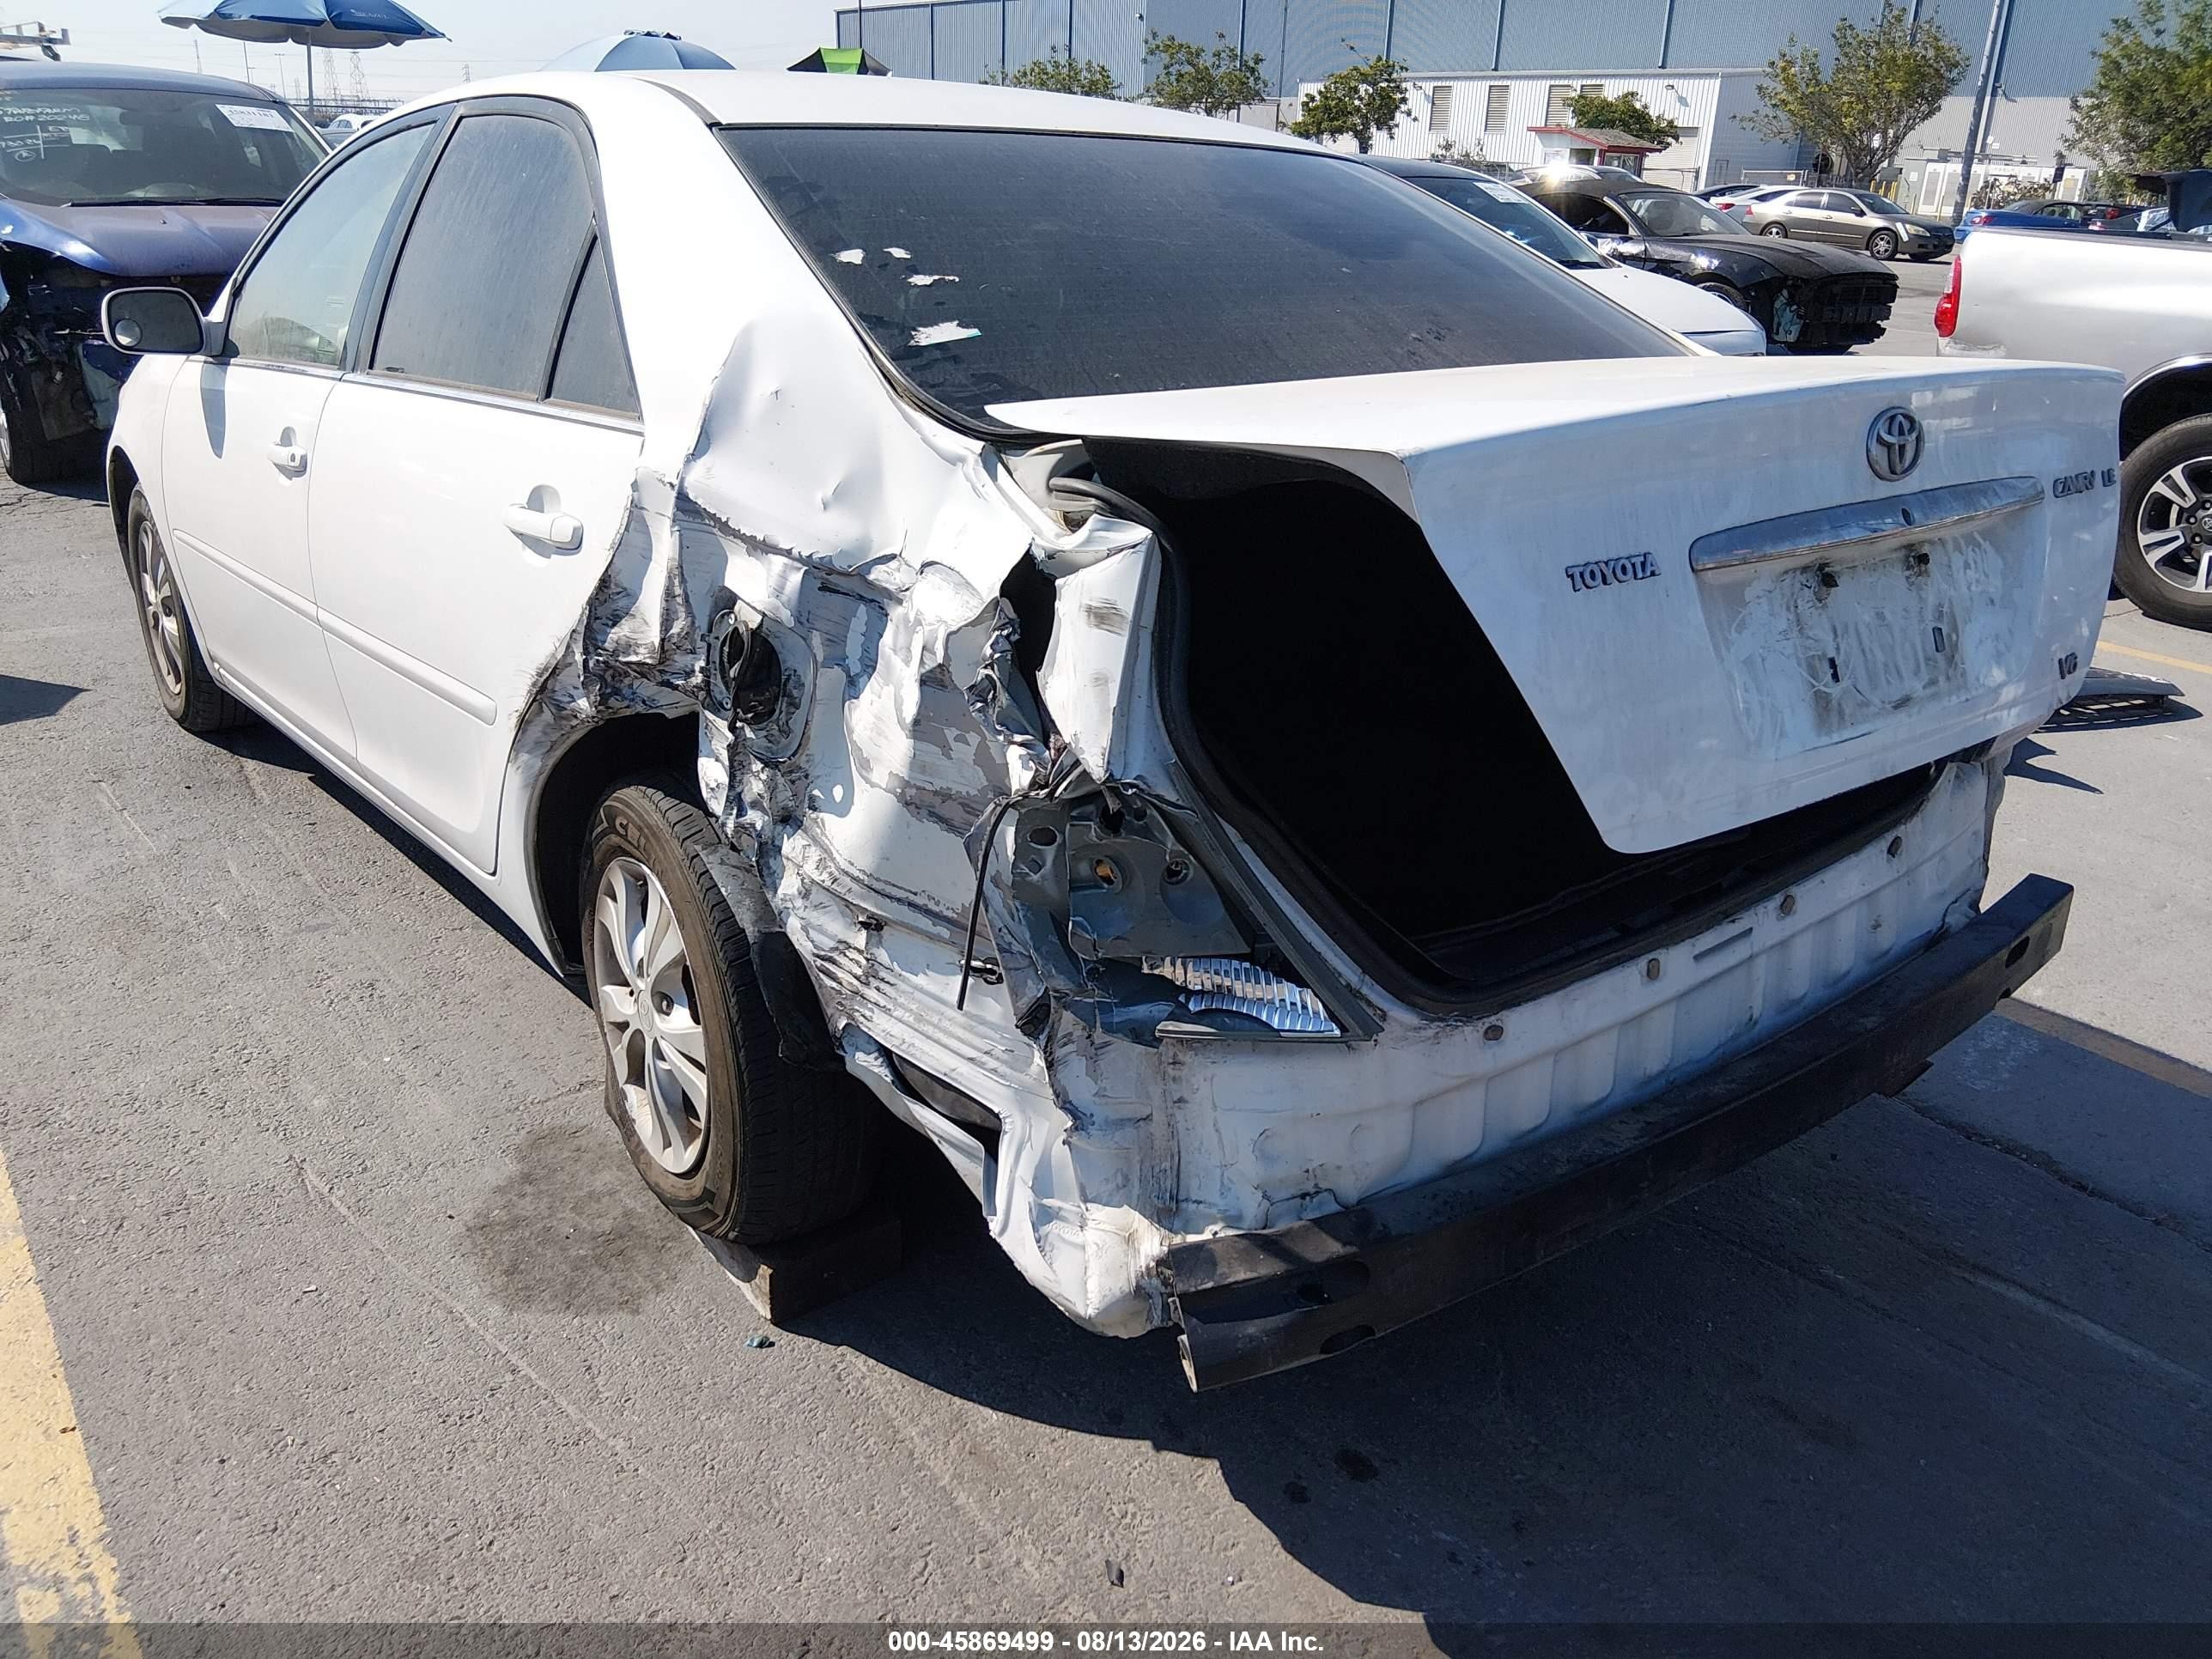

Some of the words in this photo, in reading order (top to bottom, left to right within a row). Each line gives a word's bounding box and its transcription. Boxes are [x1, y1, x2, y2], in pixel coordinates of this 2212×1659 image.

[2053, 469, 2096, 498] CAMRY
[2101, 468, 2117, 487] LE
[1565, 551, 1662, 592] TOYOTA
[2058, 652, 2078, 679] V6
